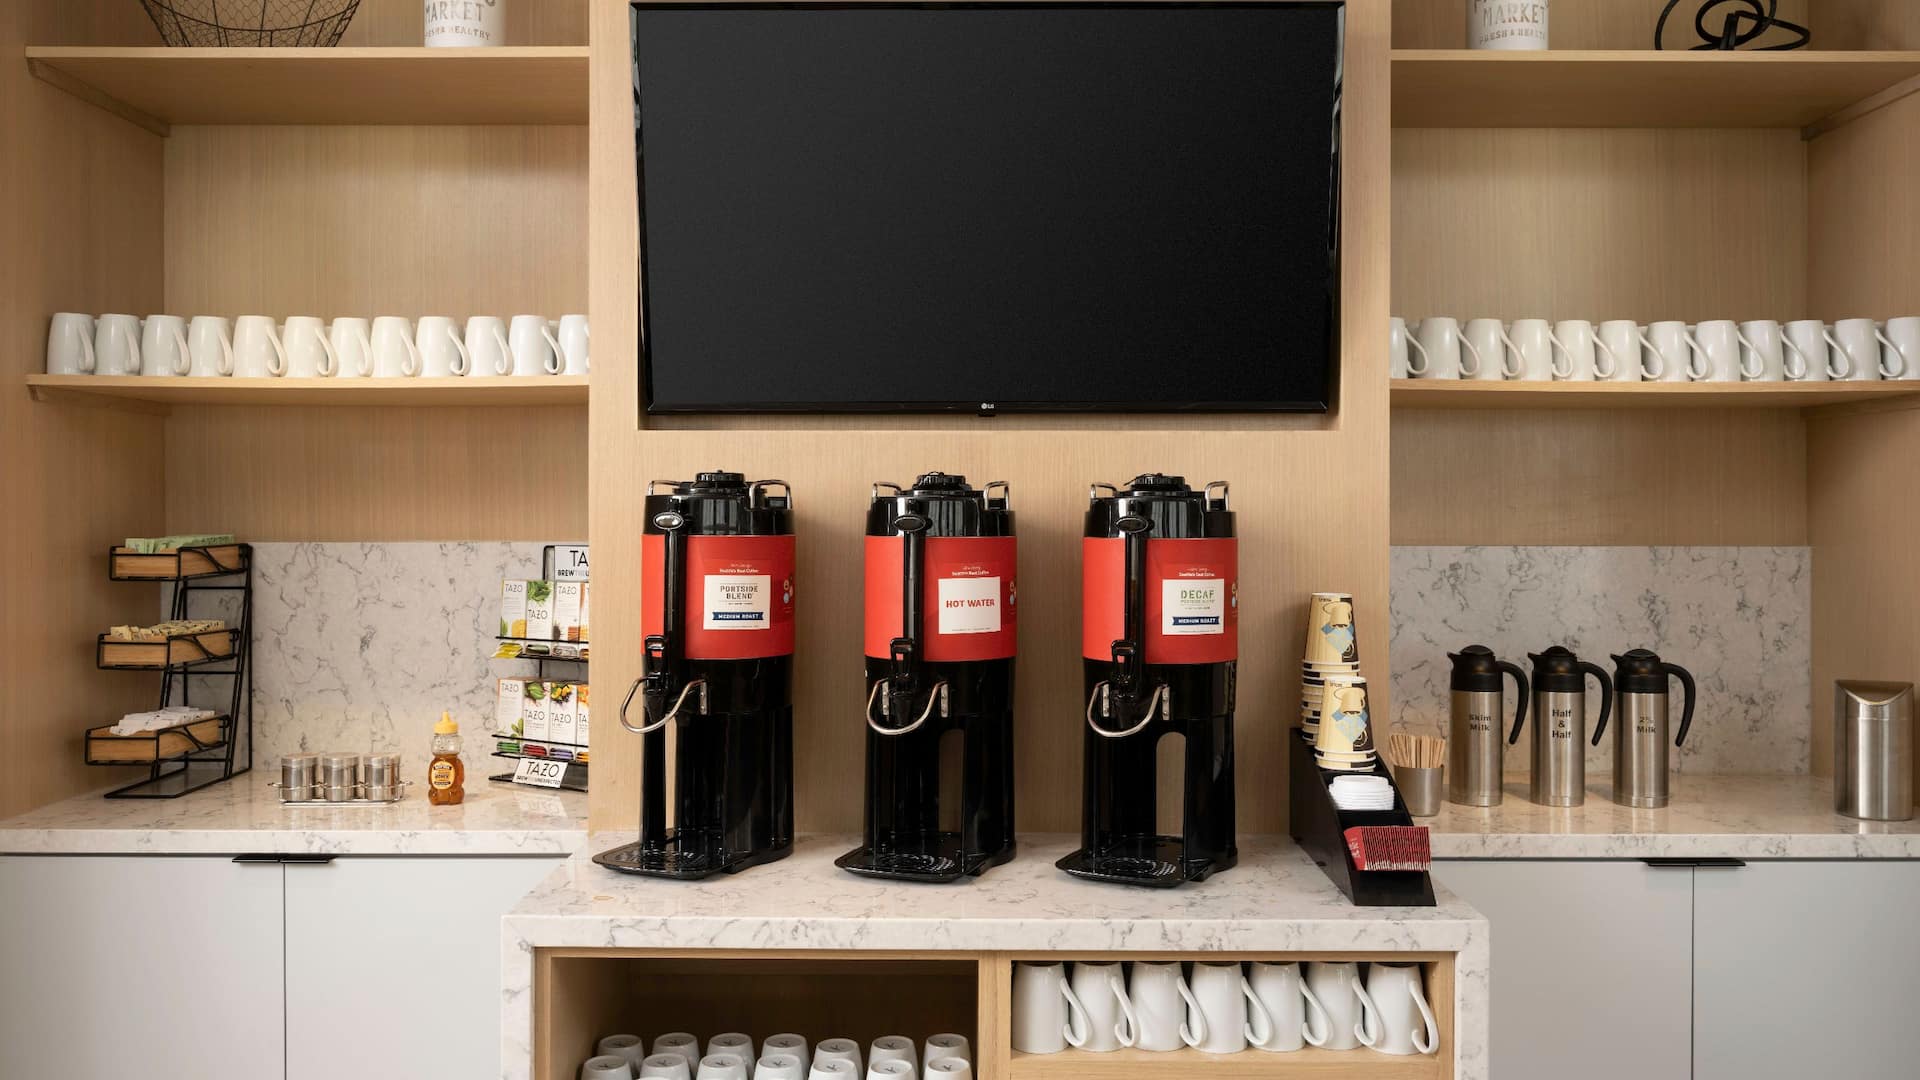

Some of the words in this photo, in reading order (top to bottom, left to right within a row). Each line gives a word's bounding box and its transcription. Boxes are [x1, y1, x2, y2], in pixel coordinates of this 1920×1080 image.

[425, 1, 485, 22] MARKET
[1482, 3, 1546, 26] MARKET
[720, 585, 759, 593] PORTSIDE
[726, 592, 753, 600] BLEND
[1180, 589, 1215, 599] DECAF
[945, 599, 965, 608] HOT
[967, 598, 995, 608] WATER
[528, 608, 548, 620] TAZO
[1469, 712, 1491, 721] Skim
[1552, 709, 1571, 717] Half
[551, 712, 572, 724] TAZO
[1469, 723, 1490, 731] Milk
[1558, 719, 1565, 728] &
[1552, 730, 1571, 738] Half
[1637, 725, 1656, 734] Milk
[526, 761, 560, 778] TAZO
